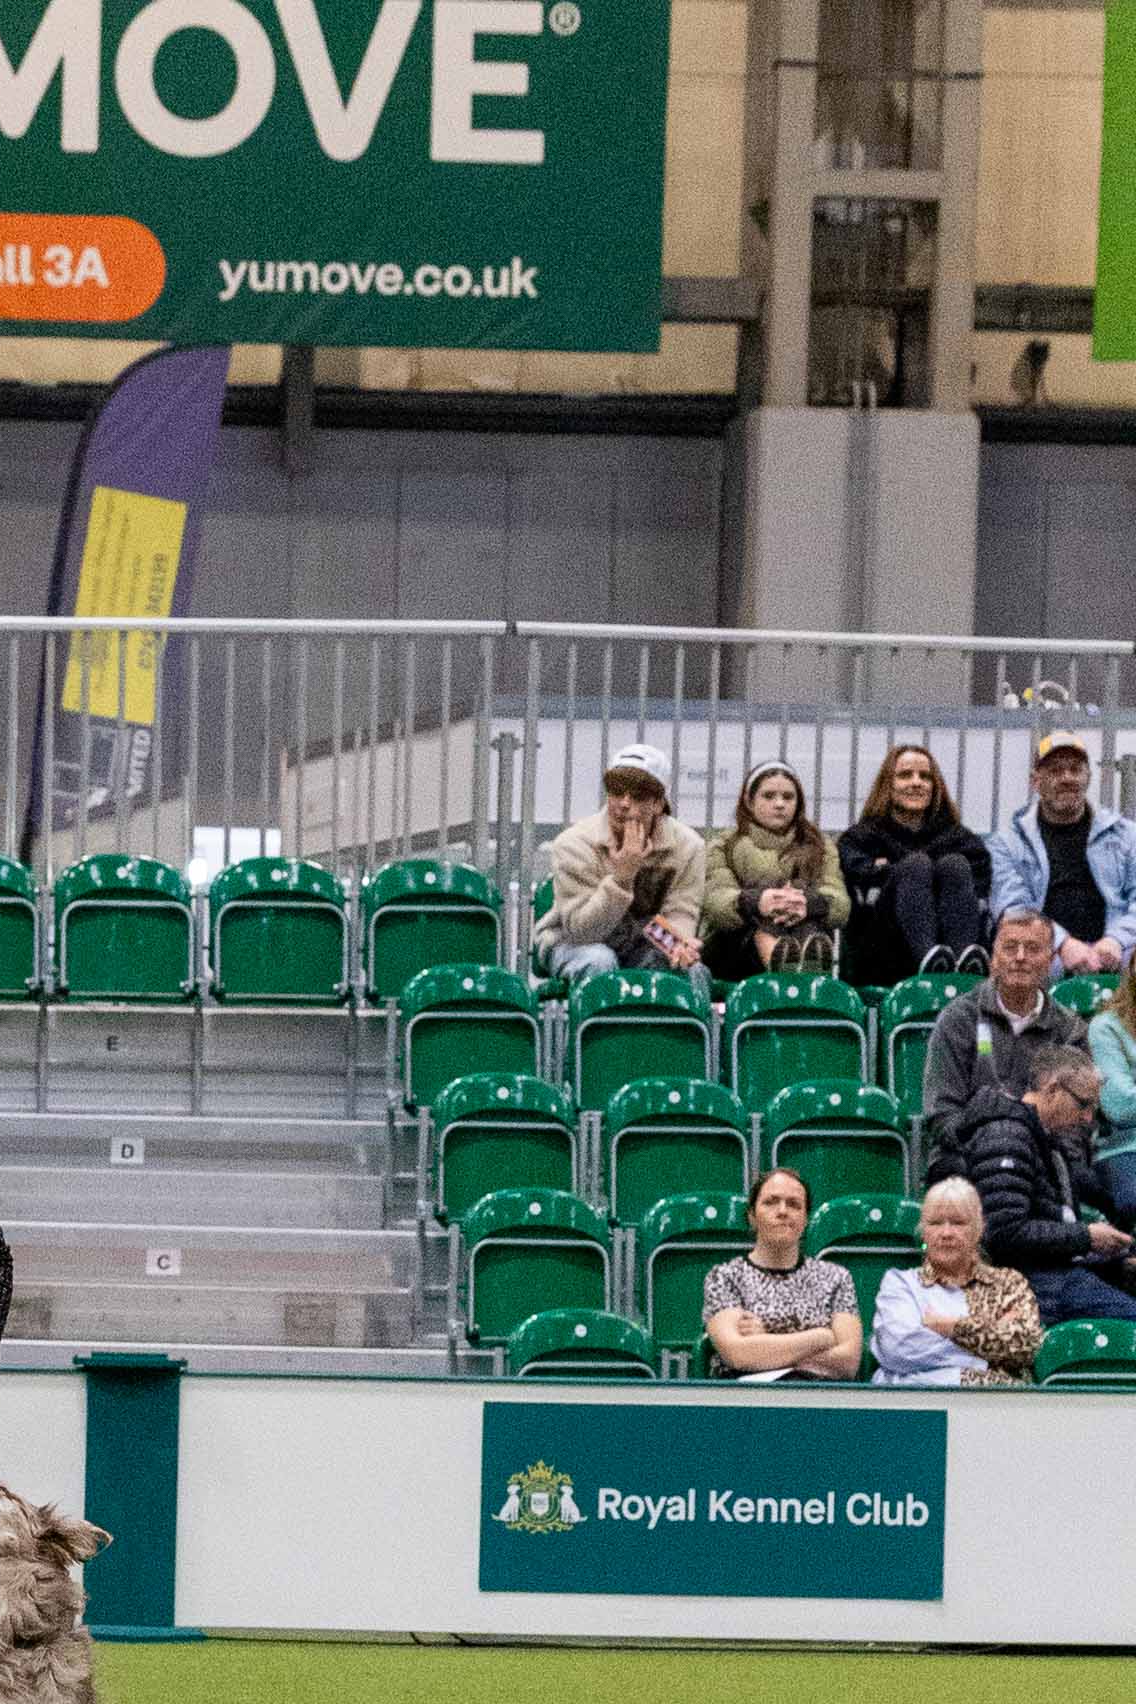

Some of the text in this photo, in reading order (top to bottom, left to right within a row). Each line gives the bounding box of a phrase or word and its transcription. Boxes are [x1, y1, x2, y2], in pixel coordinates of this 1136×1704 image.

[43, 244, 111, 288] 3A
[219, 257, 538, 301] yumove.co.uk
[106, 1035, 119, 1052] E
[120, 1142, 135, 1159] D
[156, 1253, 171, 1271] C
[597, 1487, 930, 1530] Royal Kennel Club
